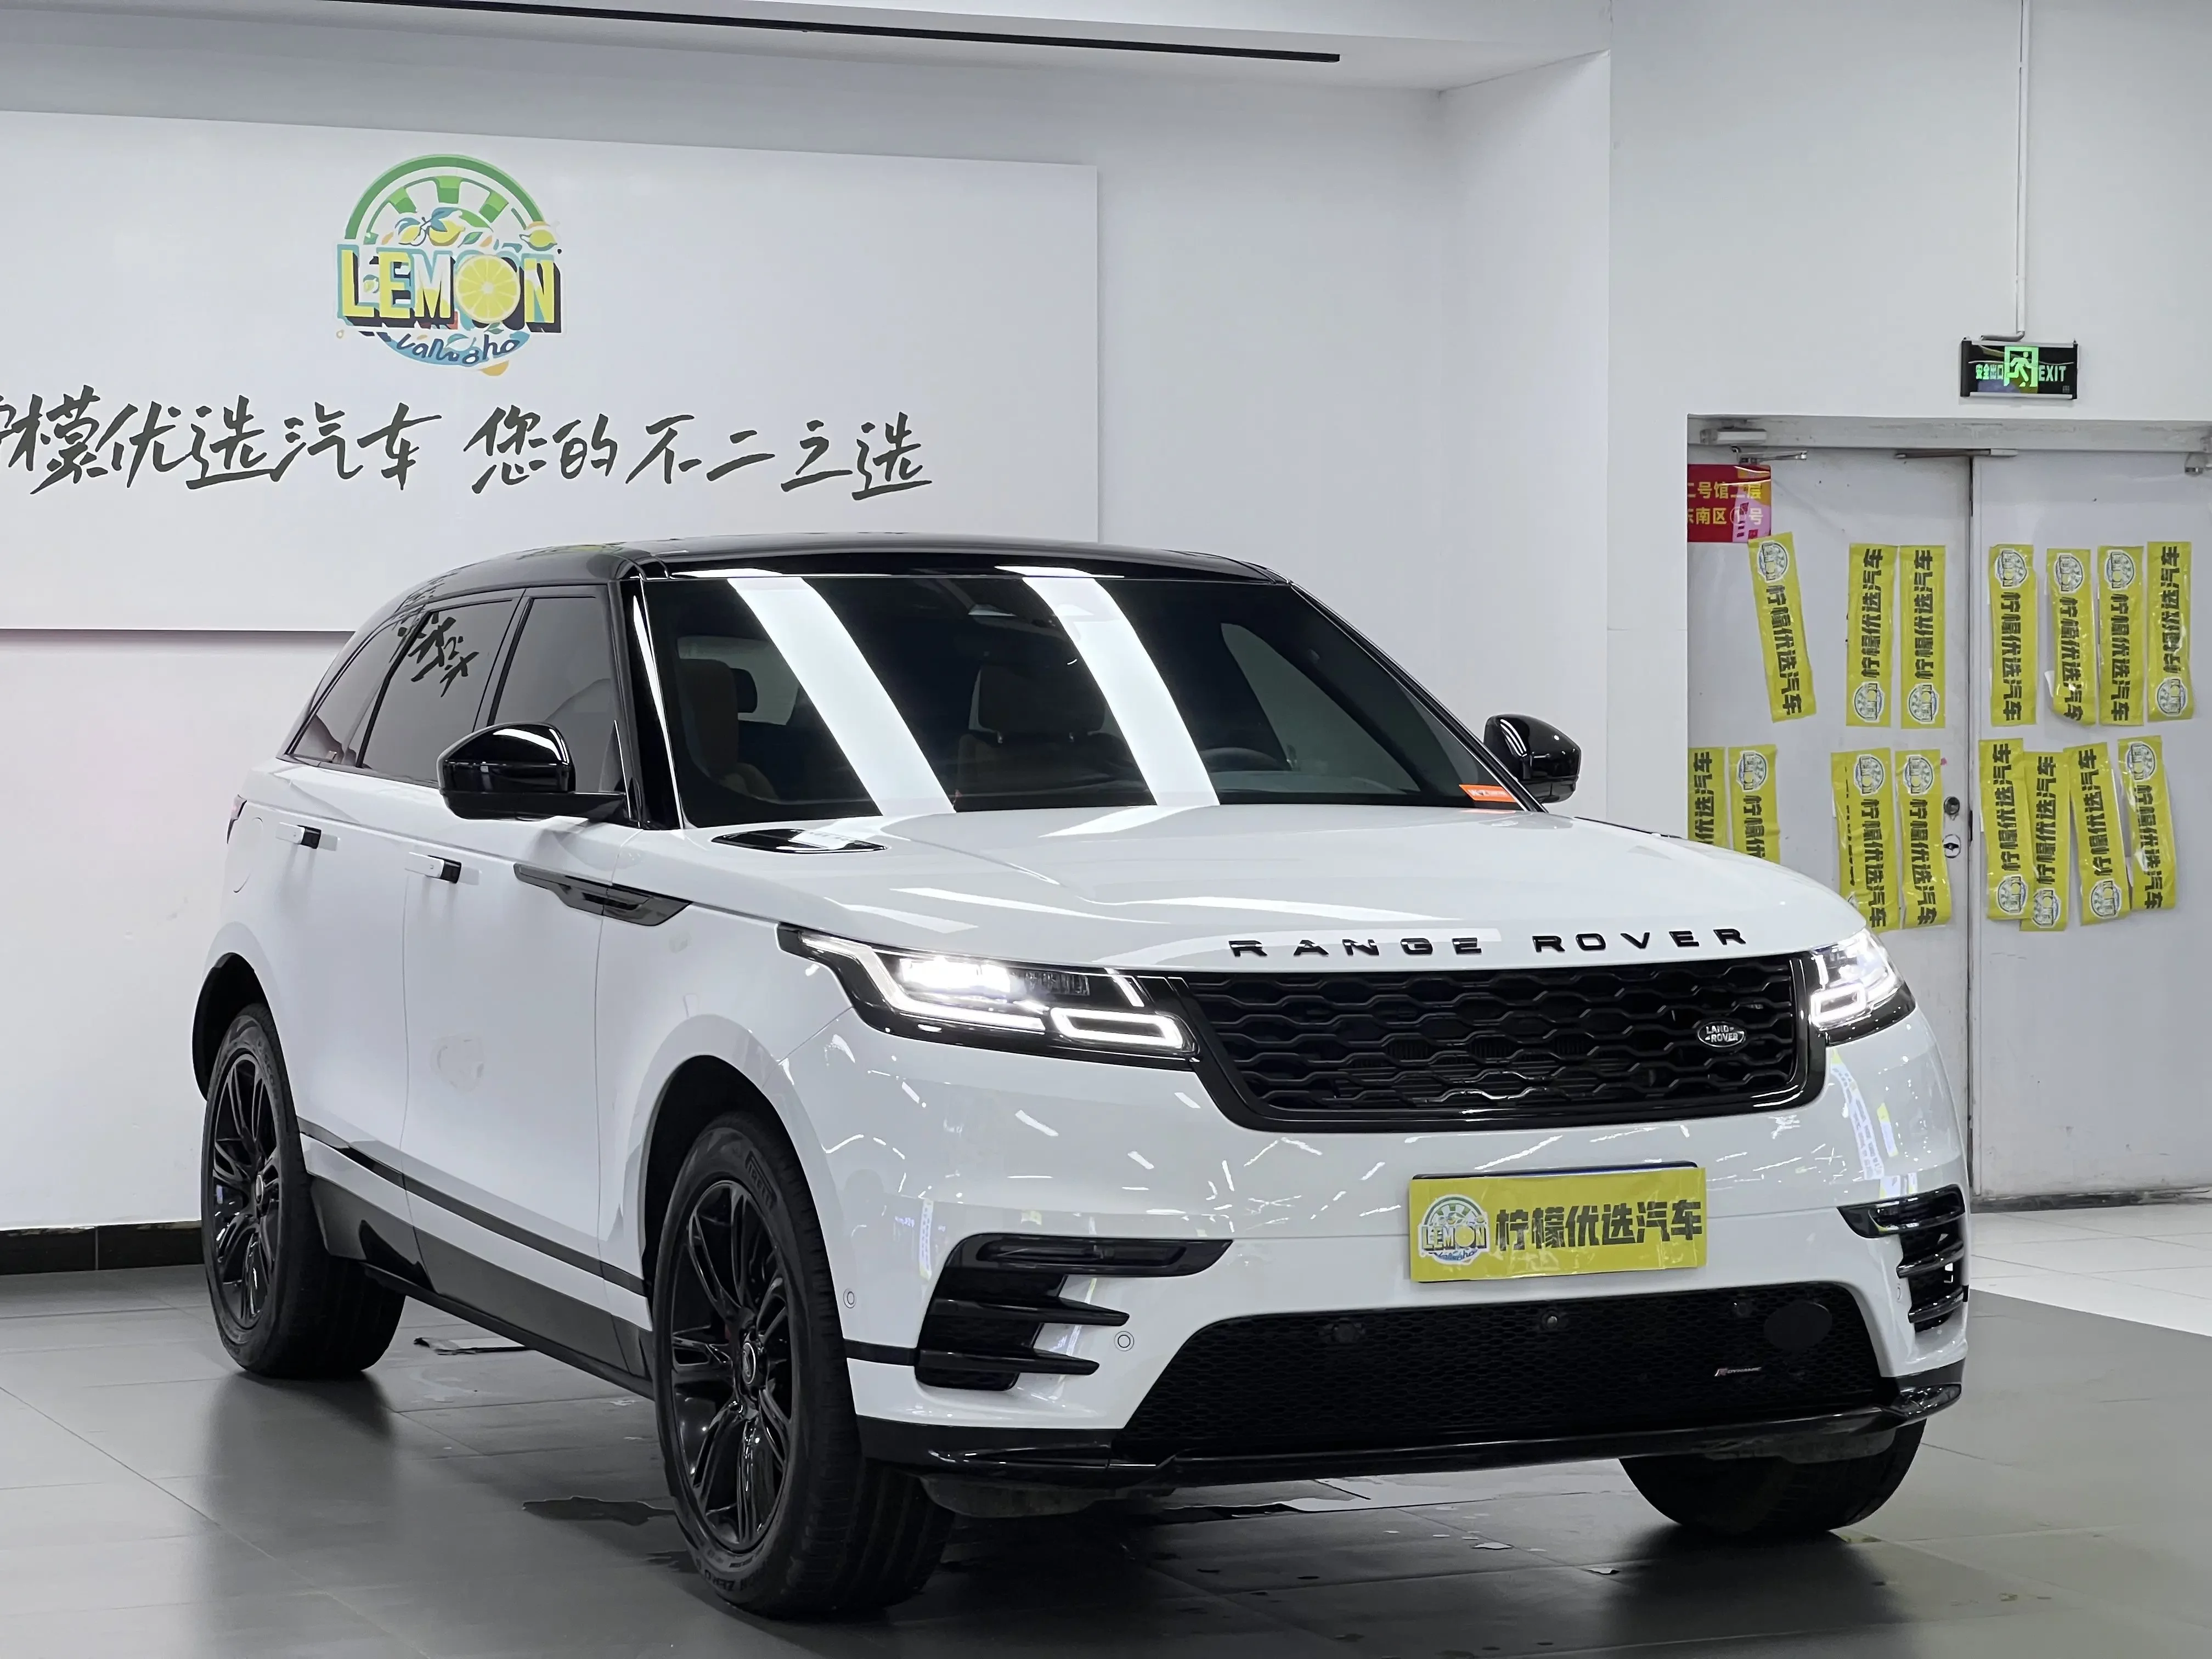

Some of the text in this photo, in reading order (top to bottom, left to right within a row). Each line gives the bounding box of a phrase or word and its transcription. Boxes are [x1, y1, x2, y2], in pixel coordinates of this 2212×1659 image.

[338, 245, 561, 332] LEMON
[2039, 365, 2067, 382] EXIT
[463, 404, 932, 501] 您的不二之选
[1228, 928, 1746, 957] RANGE ROVER
[1706, 1025, 1729, 1034] LAND
[1711, 1032, 1738, 1042] ROVER
[1421, 1226, 1487, 1251] LEMON
[1495, 1199, 1702, 1251] 柠檬优选汽车
